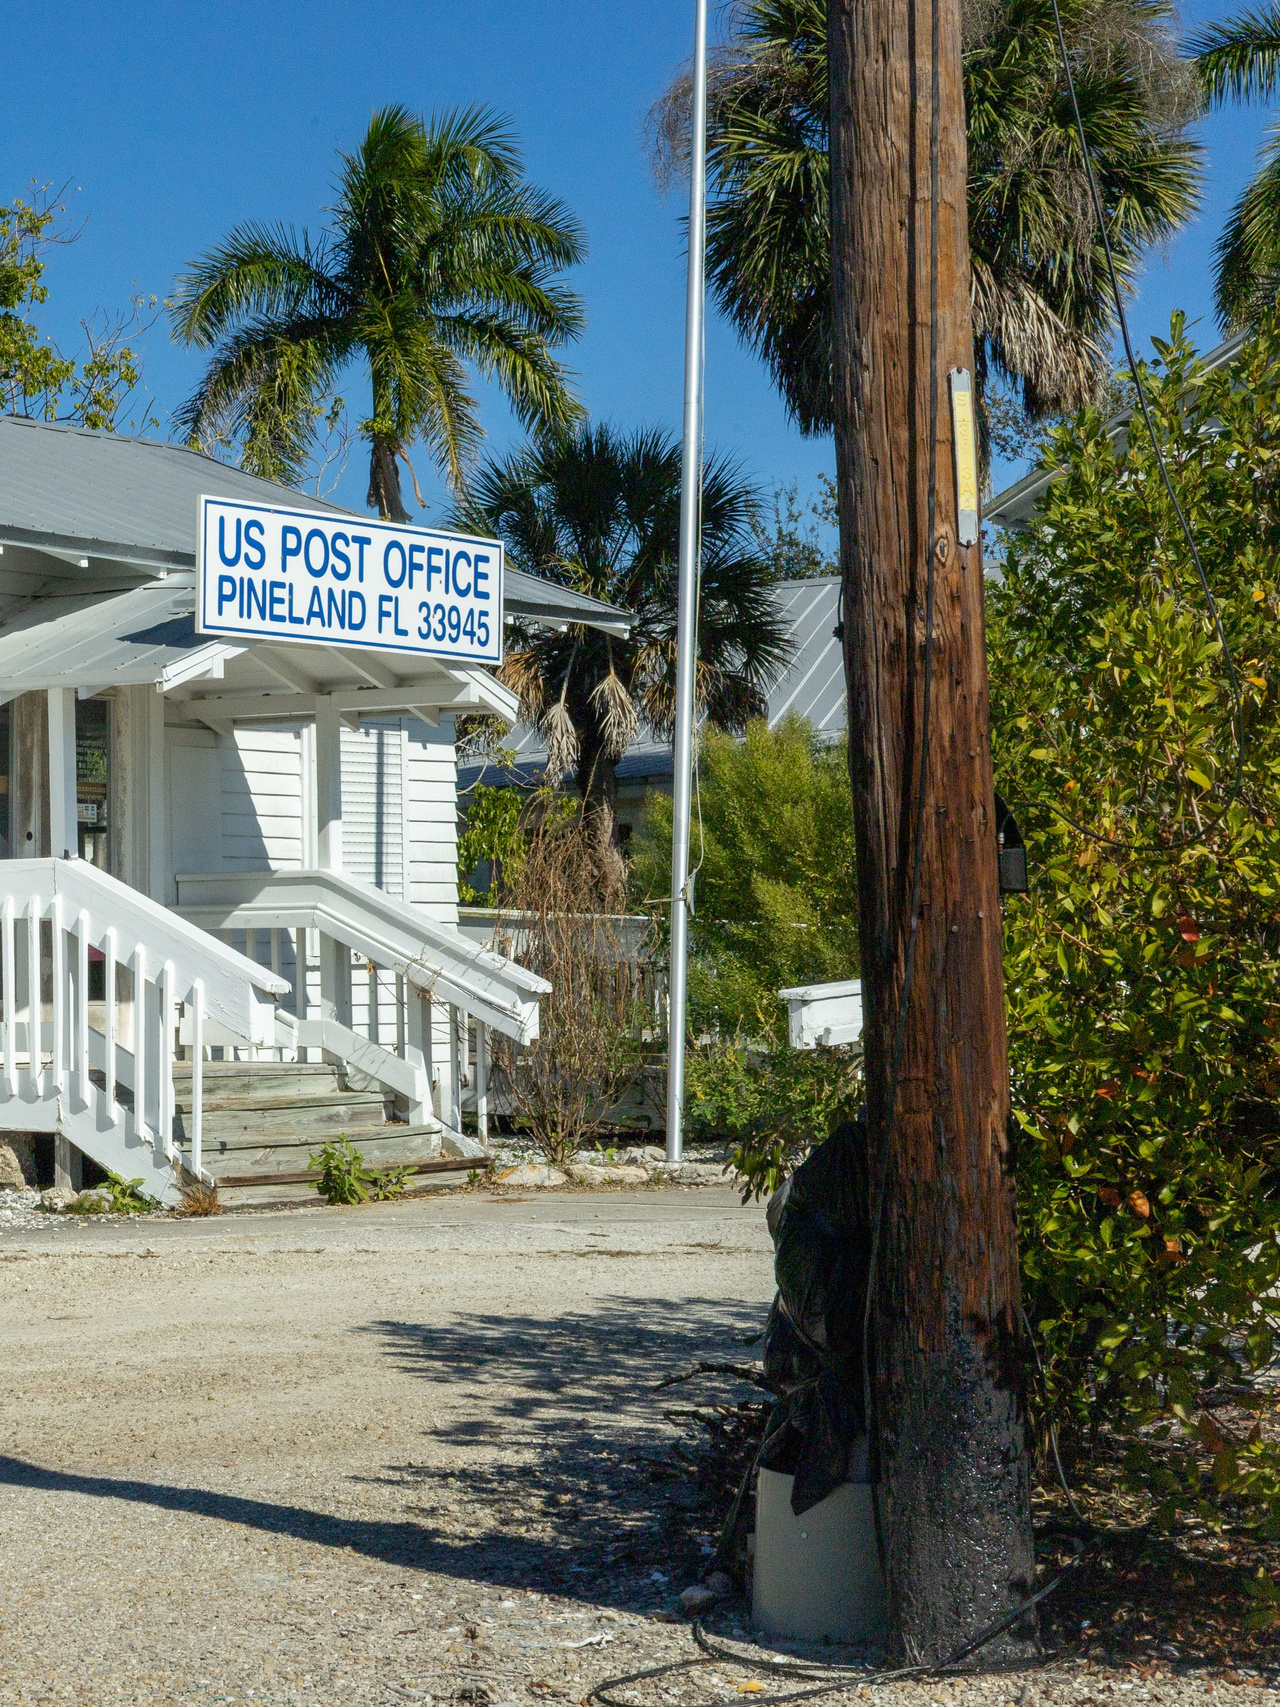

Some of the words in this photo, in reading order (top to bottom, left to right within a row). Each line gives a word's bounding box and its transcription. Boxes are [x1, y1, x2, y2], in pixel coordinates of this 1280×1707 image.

[219, 515, 266, 571] US
[281, 525, 372, 583] POST
[383, 540, 491, 600] OFFICE
[217, 574, 367, 631] PINELAND
[378, 594, 409, 637] FL
[417, 601, 490, 647] 33945
